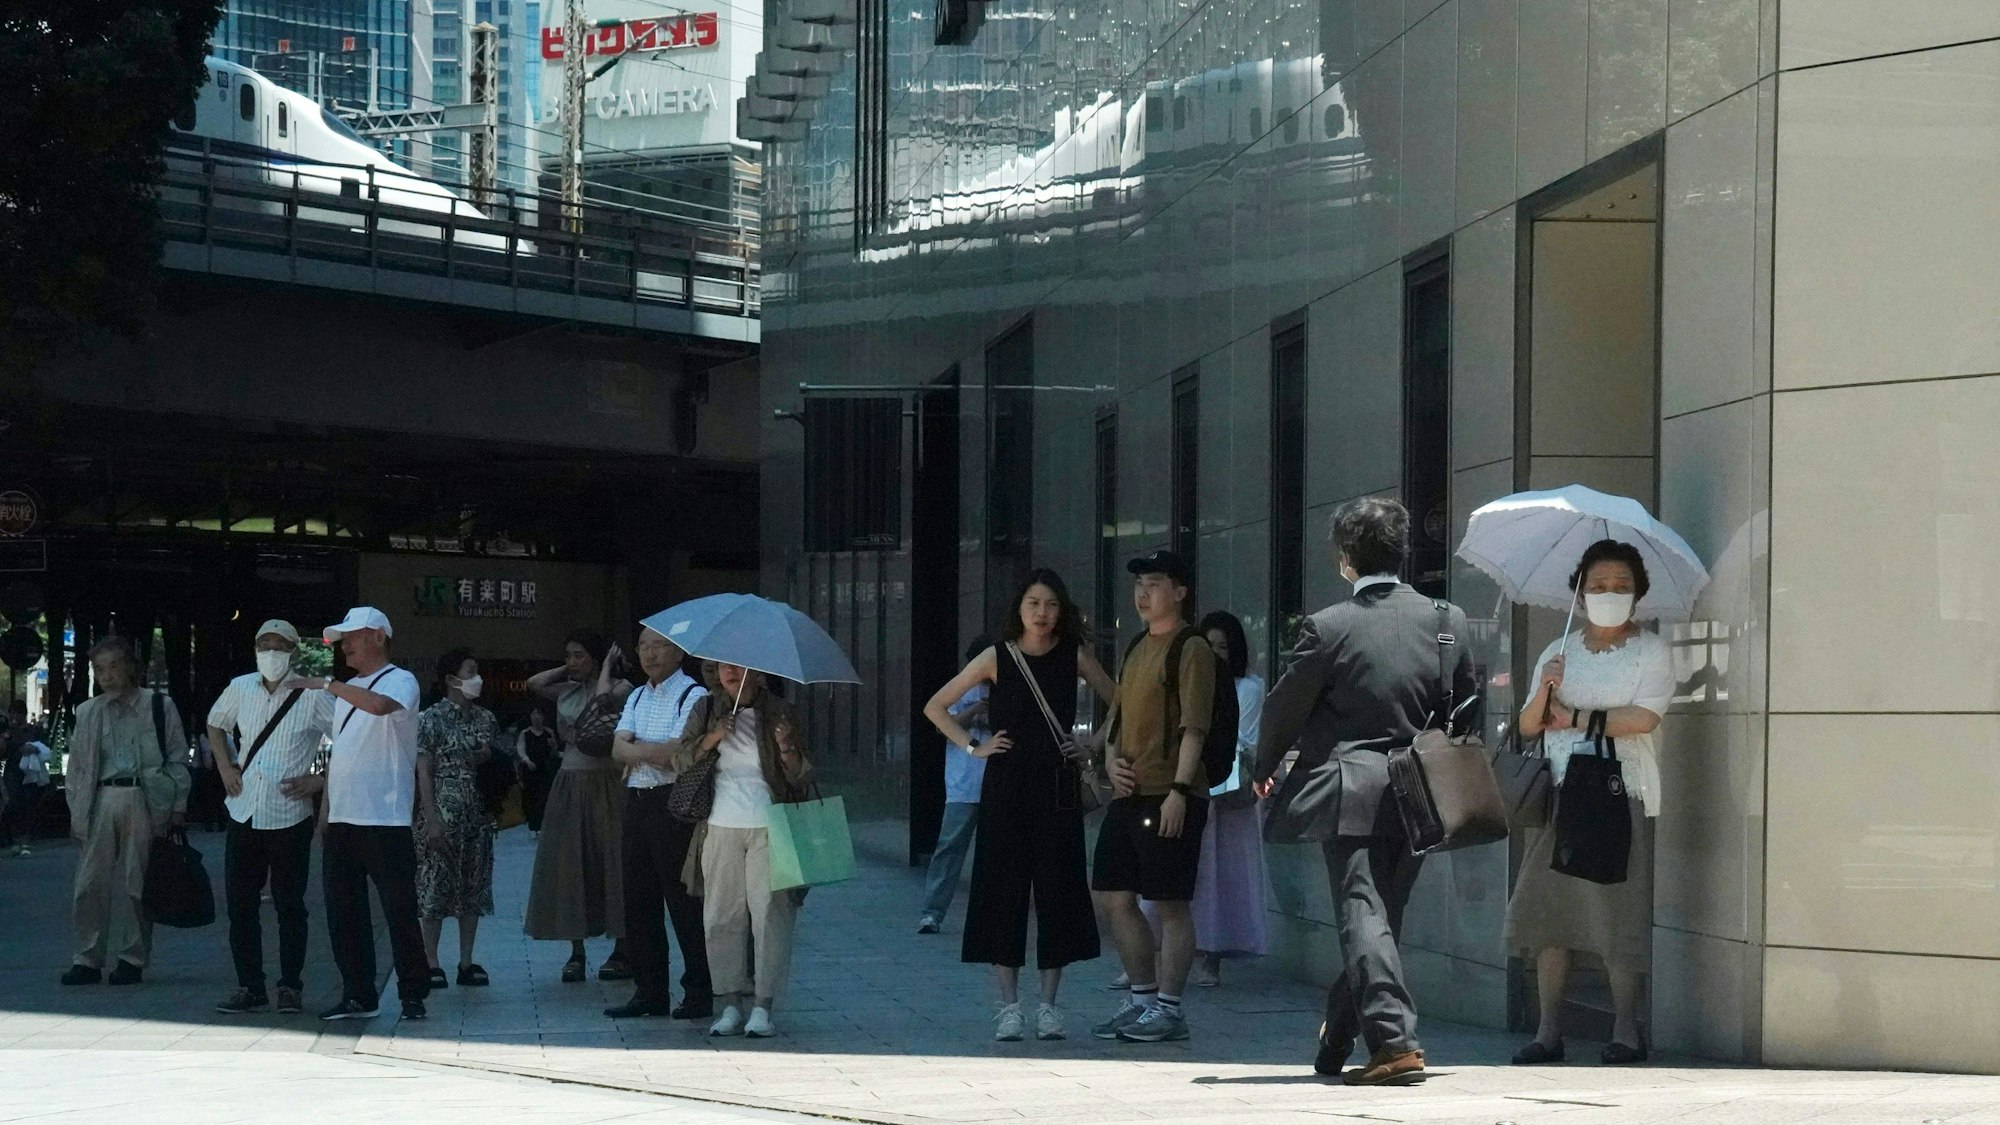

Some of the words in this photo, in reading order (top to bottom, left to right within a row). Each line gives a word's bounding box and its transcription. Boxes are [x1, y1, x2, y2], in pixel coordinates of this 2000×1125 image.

[540, 96, 587, 123] BI
[596, 82, 719, 120] CAMERA
[458, 578, 536, 604] 有楽町駅
[458, 606, 505, 617] Yurakucho
[507, 607, 536, 618] Station
